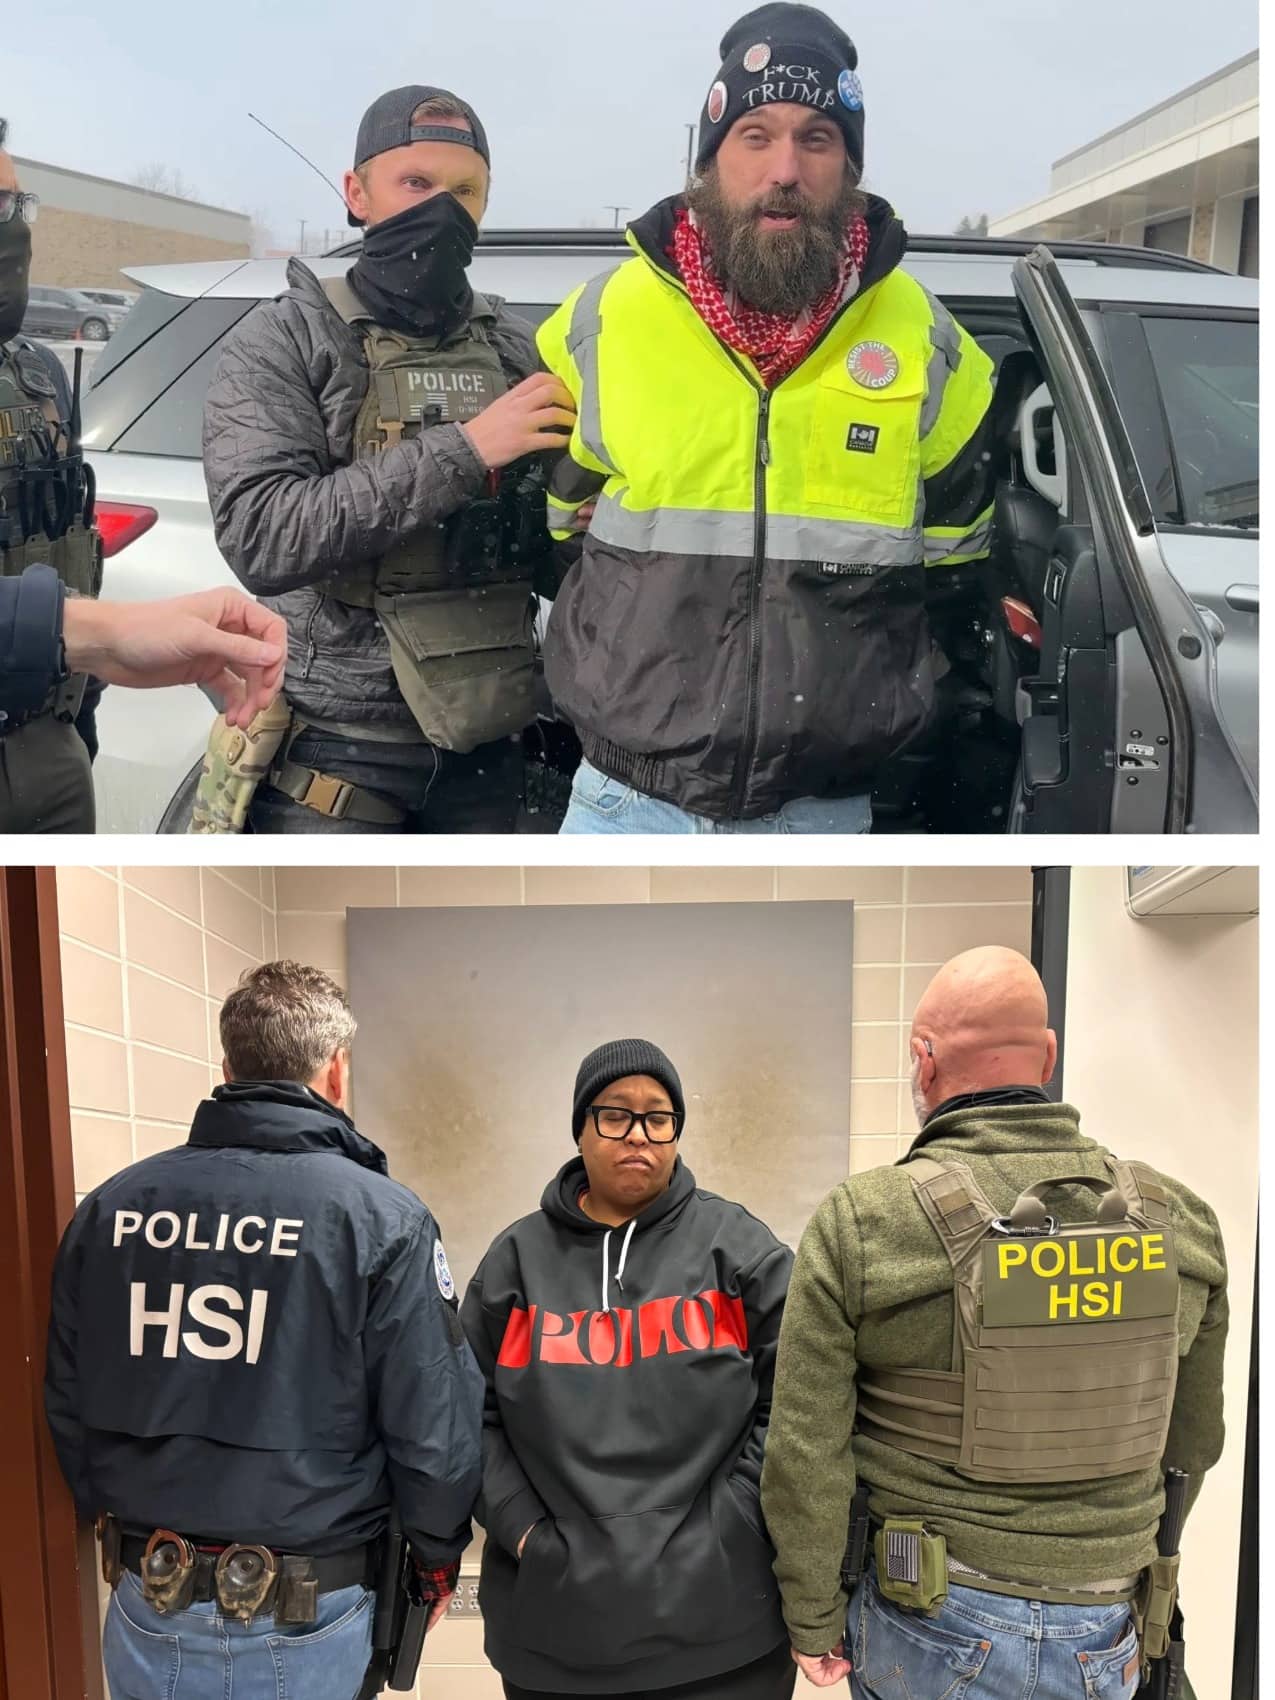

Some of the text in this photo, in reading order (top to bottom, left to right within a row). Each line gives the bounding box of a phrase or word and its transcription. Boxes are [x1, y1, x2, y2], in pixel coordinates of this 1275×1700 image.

[742, 81, 836, 109] TRUMP
[408, 371, 486, 393] POLICE
[871, 369, 895, 388] COUP
[112, 1209, 304, 1257] POLICE
[998, 1234, 1166, 1279] POLICE
[1048, 1280, 1123, 1319] HSI
[129, 1281, 269, 1365] HSI
